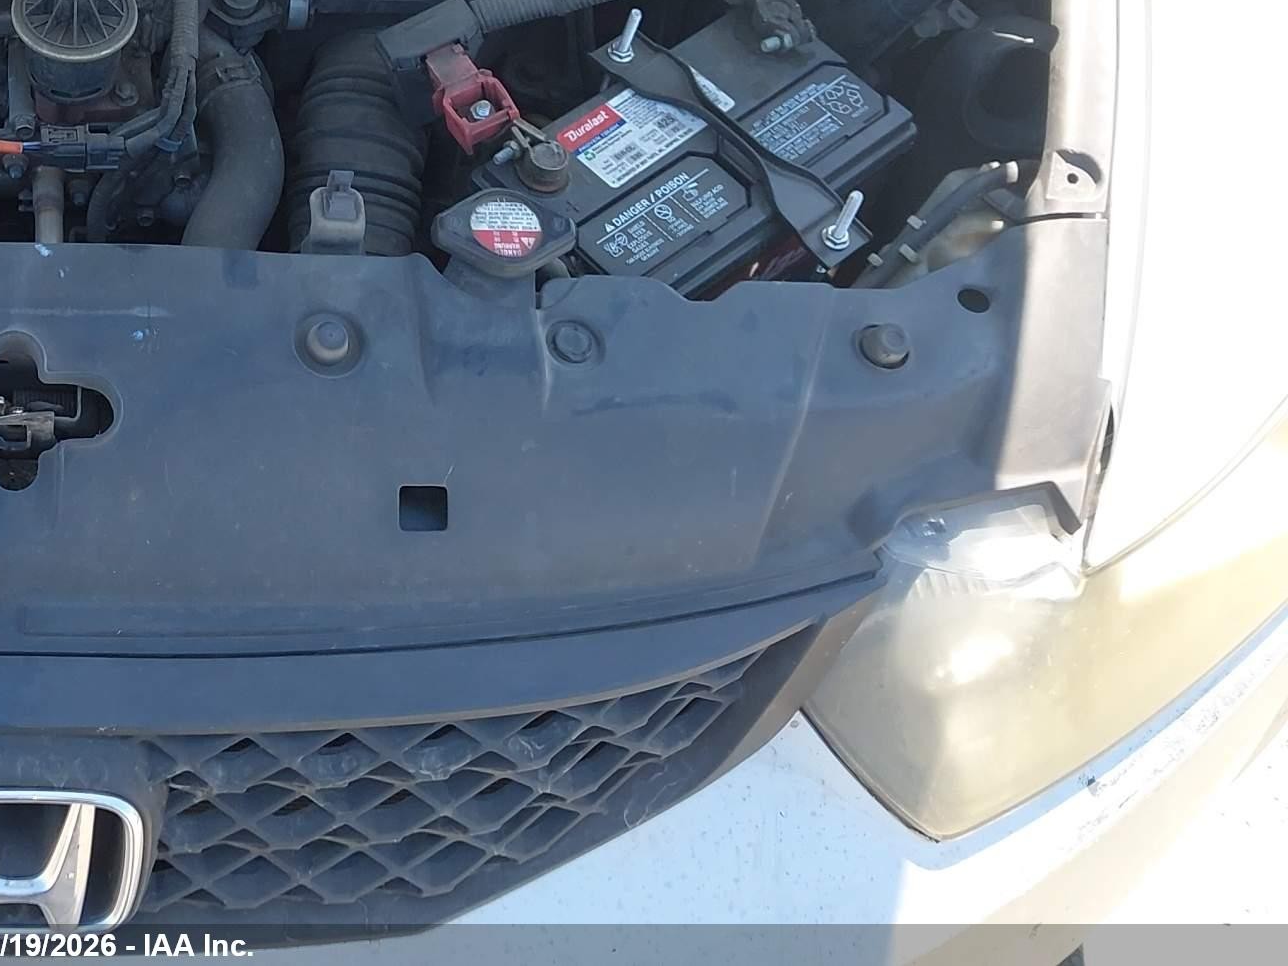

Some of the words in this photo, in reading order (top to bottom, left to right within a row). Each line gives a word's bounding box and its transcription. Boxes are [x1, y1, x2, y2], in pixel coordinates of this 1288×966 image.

[563, 109, 610, 143] Duralast
[612, 198, 651, 227] DANGER
[654, 172, 690, 198] POISON
